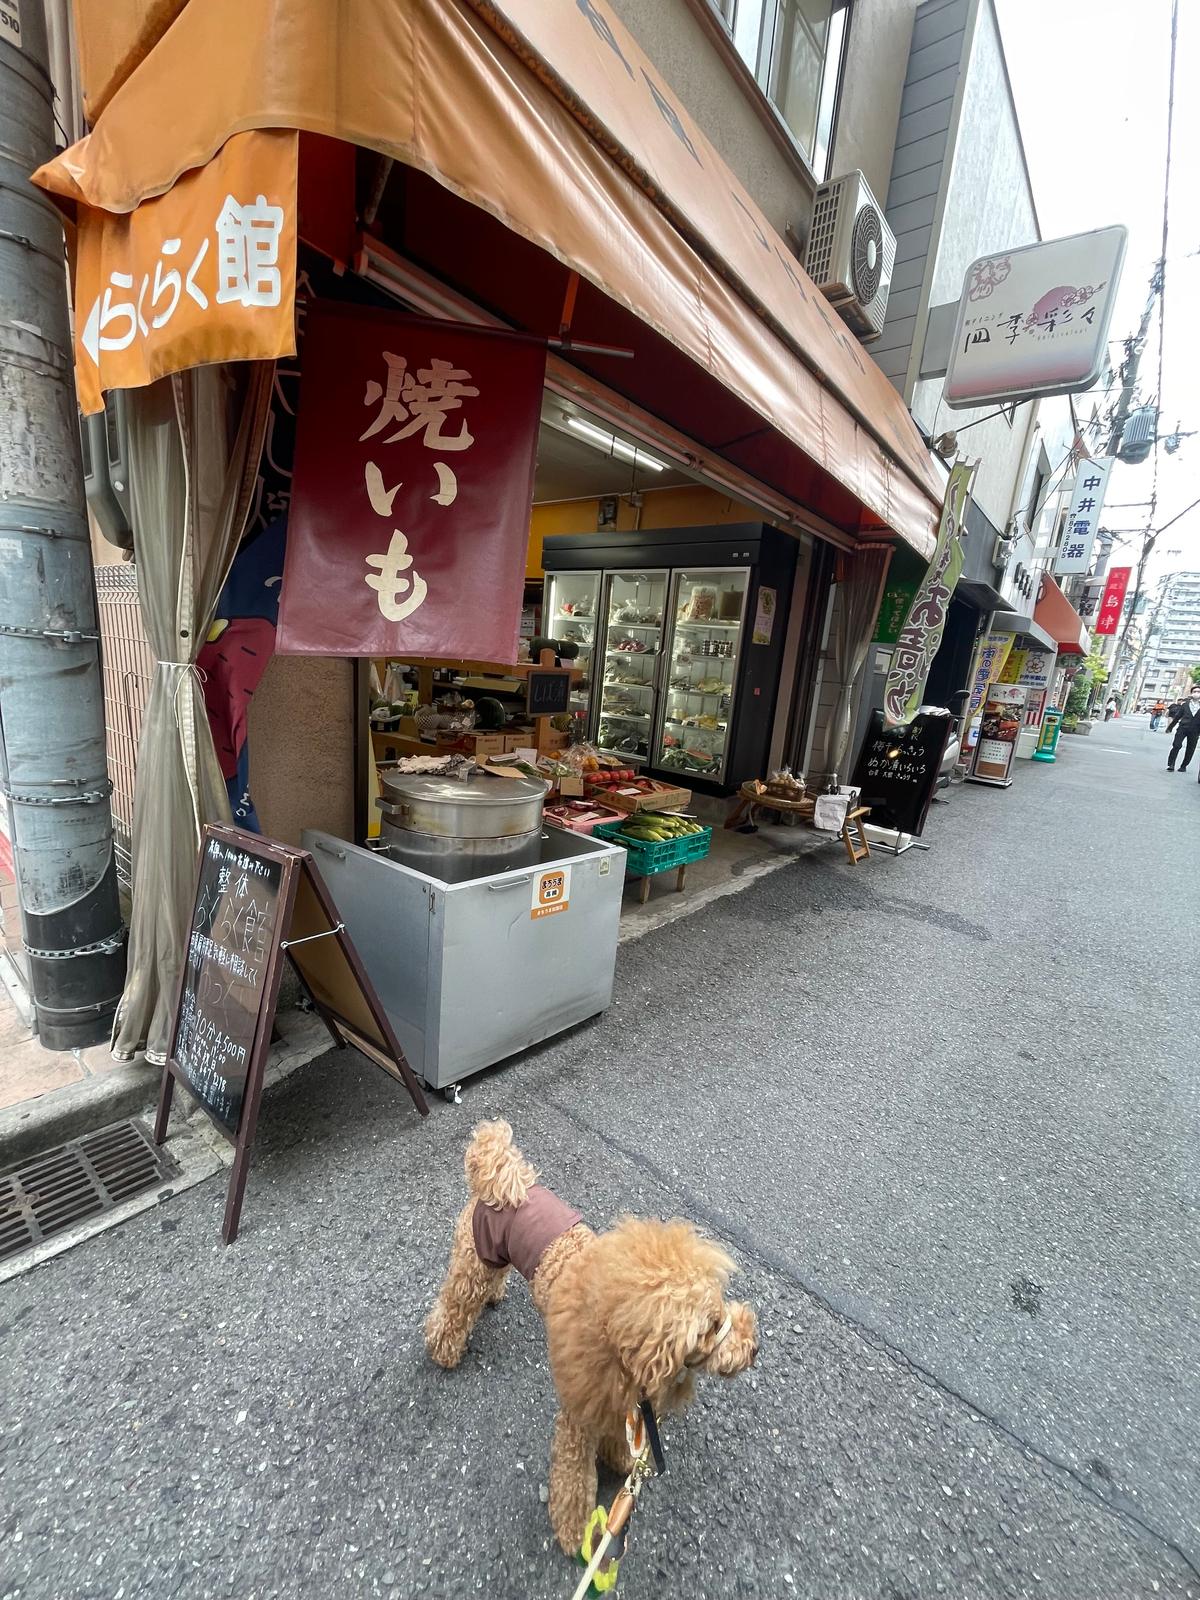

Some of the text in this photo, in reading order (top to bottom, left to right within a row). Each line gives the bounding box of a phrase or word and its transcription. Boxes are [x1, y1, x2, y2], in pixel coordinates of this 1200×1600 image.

[100, 194, 284, 351] らくらく館
[964, 306, 1096, 354] 四季彩々
[358, 350, 481, 622] 焼いも
[1067, 475, 1102, 559] 中井電器
[196, 884, 272, 963] らくらく館
